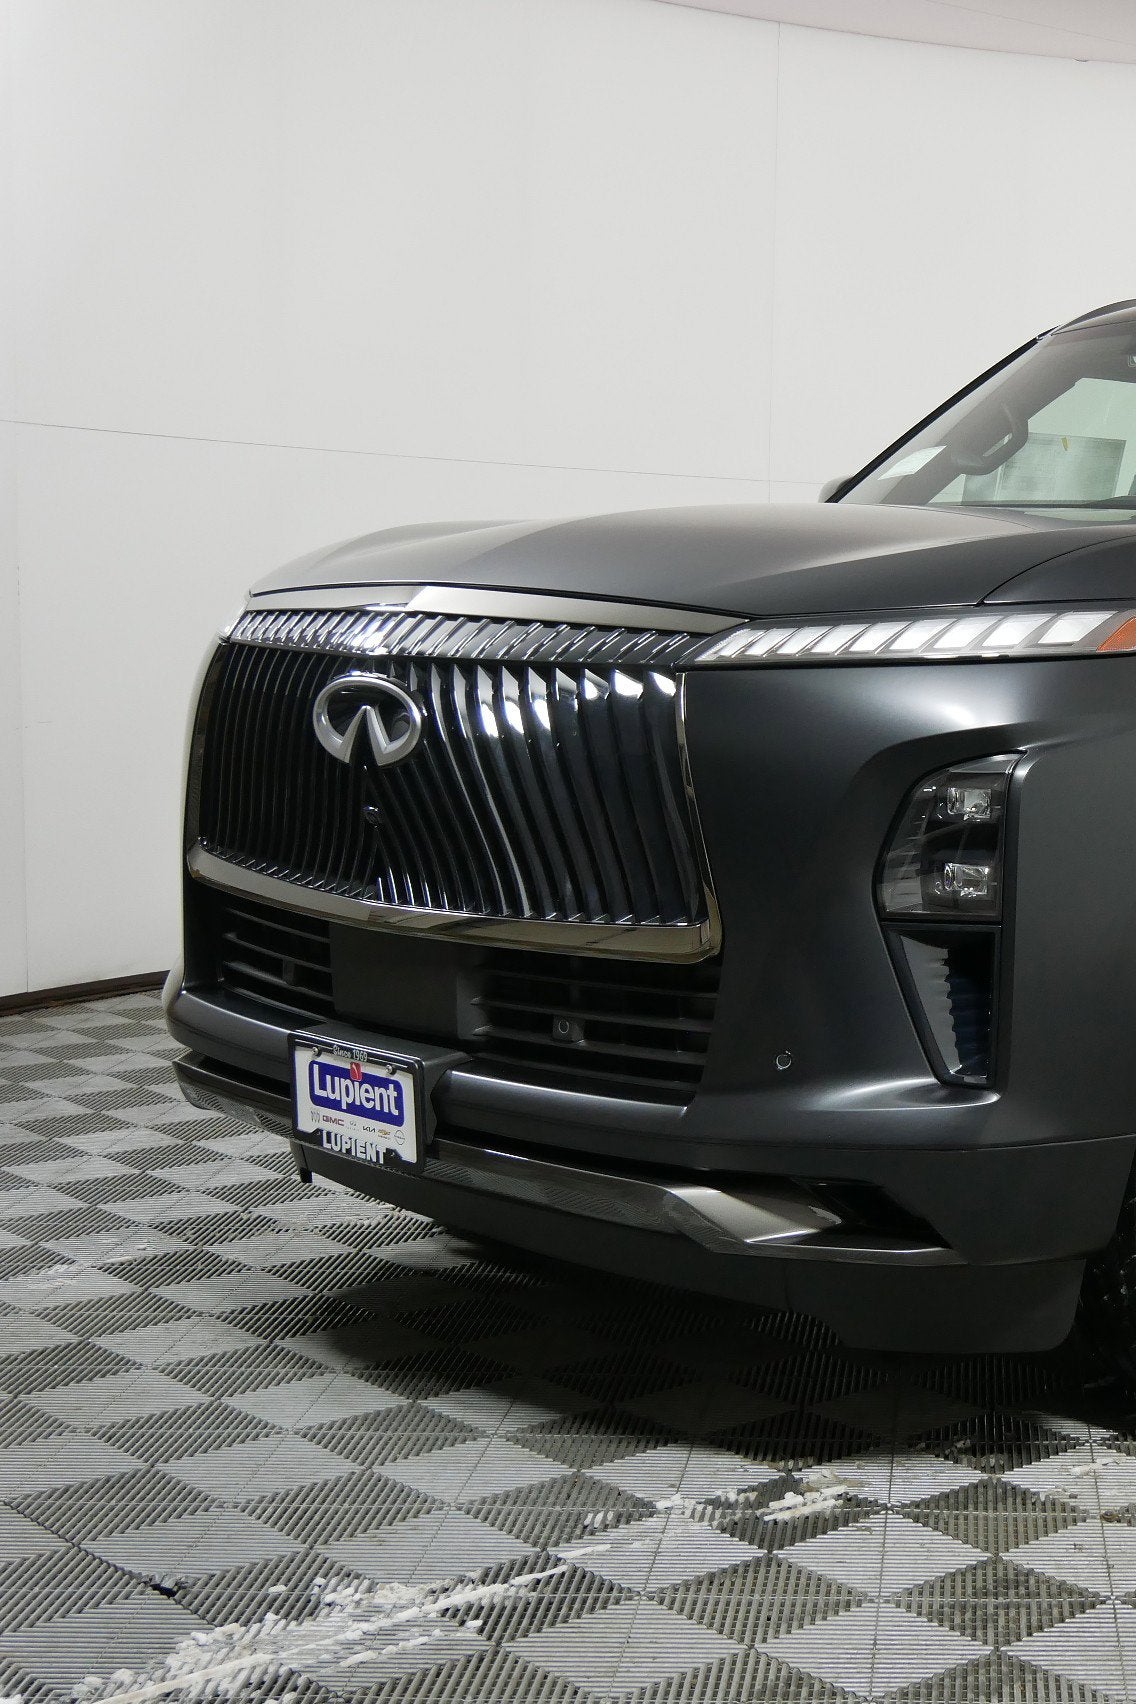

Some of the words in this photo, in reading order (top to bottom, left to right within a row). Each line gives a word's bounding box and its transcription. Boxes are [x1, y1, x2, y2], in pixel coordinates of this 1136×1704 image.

[332, 1045, 351, 1058] Since
[353, 1049, 368, 1062] 1969
[313, 1064, 399, 1116] Lupient
[322, 1115, 345, 1127] GMC
[322, 1130, 387, 1164] LUPIENT
